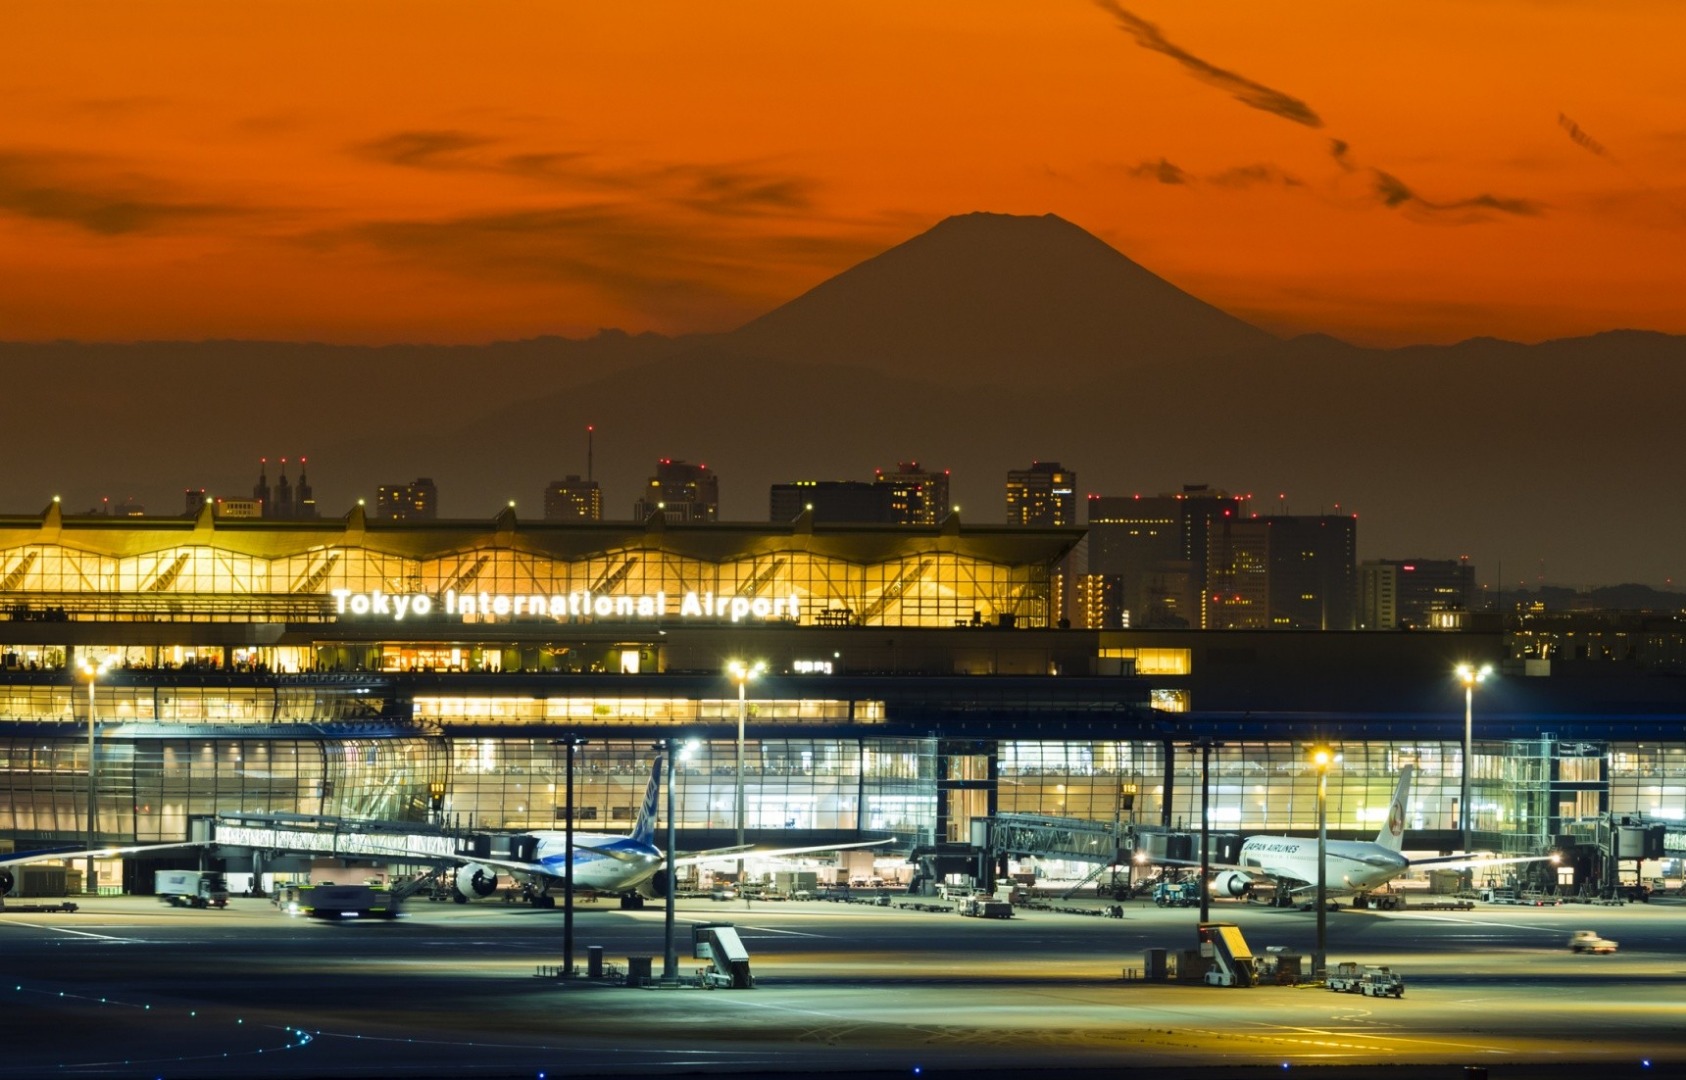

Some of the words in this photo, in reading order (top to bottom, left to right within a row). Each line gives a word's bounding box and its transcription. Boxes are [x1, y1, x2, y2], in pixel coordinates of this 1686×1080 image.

[332, 589, 431, 620] Tokyo
[445, 589, 664, 614] International
[681, 590, 800, 622] Airport
[1123, 784, 1136, 793] 112
[636, 776, 657, 829] ANA
[1244, 842, 1268, 852] JAPAN
[1268, 843, 1300, 854] AIRLINES
